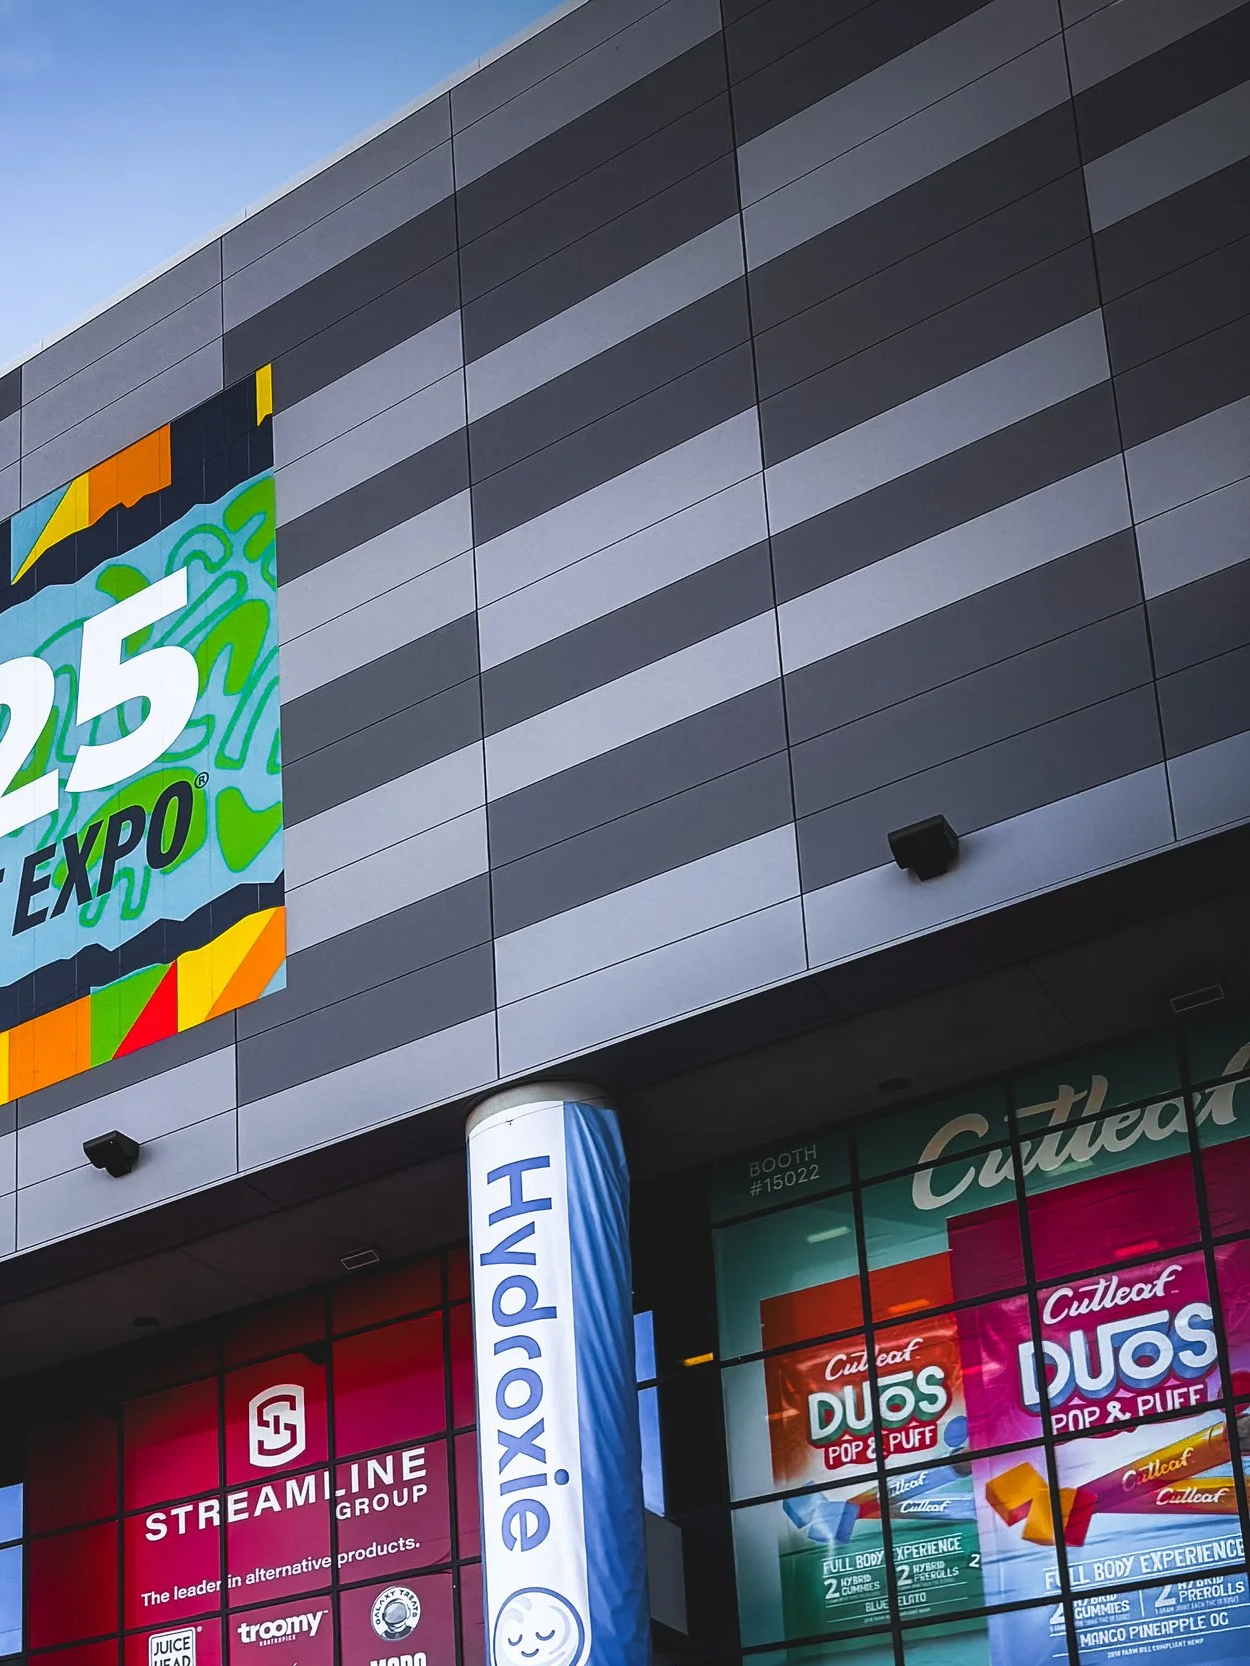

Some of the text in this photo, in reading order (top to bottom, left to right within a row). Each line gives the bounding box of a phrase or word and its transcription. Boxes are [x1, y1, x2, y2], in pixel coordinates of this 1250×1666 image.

[749, 1144, 817, 1177] BOOTH
[749, 1164, 820, 1197] #15022
[1043, 1265, 1182, 1325] Cutleaf
[480, 1154, 570, 1553] Hydroxie
[825, 1338, 924, 1381] Cutleaf
[1018, 1302, 1219, 1406] DUOS
[808, 1366, 948, 1440] DUOS
[1052, 1407, 1100, 1436] POP
[1137, 1384, 1205, 1417] PUFF
[829, 1425, 936, 1465] POP PUFF
[145, 1446, 427, 1542] STREAMLINE
[335, 1484, 429, 1520] GROUP
[1156, 1487, 1230, 1506] Cutleaf
[141, 1537, 421, 1607] The leader in alternative products.
[823, 1557, 854, 1575] FULL
[856, 1550, 885, 1569] BODY
[896, 1565, 912, 1586] 2
[913, 1561, 946, 1573] HYBRID
[914, 1567, 960, 1583] PREROLLS
[1094, 1555, 1135, 1582] BODY
[1140, 1538, 1245, 1574] EXPERIENCE
[824, 1578, 840, 1599] 2
[840, 1574, 872, 1587] HYBRID
[841, 1581, 880, 1596] GUMMIES
[865, 1592, 926, 1613] BLUE ELATO
[1180, 1581, 1246, 1603] PREROLLS
[1075, 1600, 1130, 1619] GUMMIES
[237, 1610, 323, 1643] troomy
[1080, 1628, 1126, 1648] MANGO
[1129, 1615, 1206, 1639] PINEAPPLE
[1210, 1612, 1228, 1627] OG
[154, 1636, 191, 1656] JUICE
